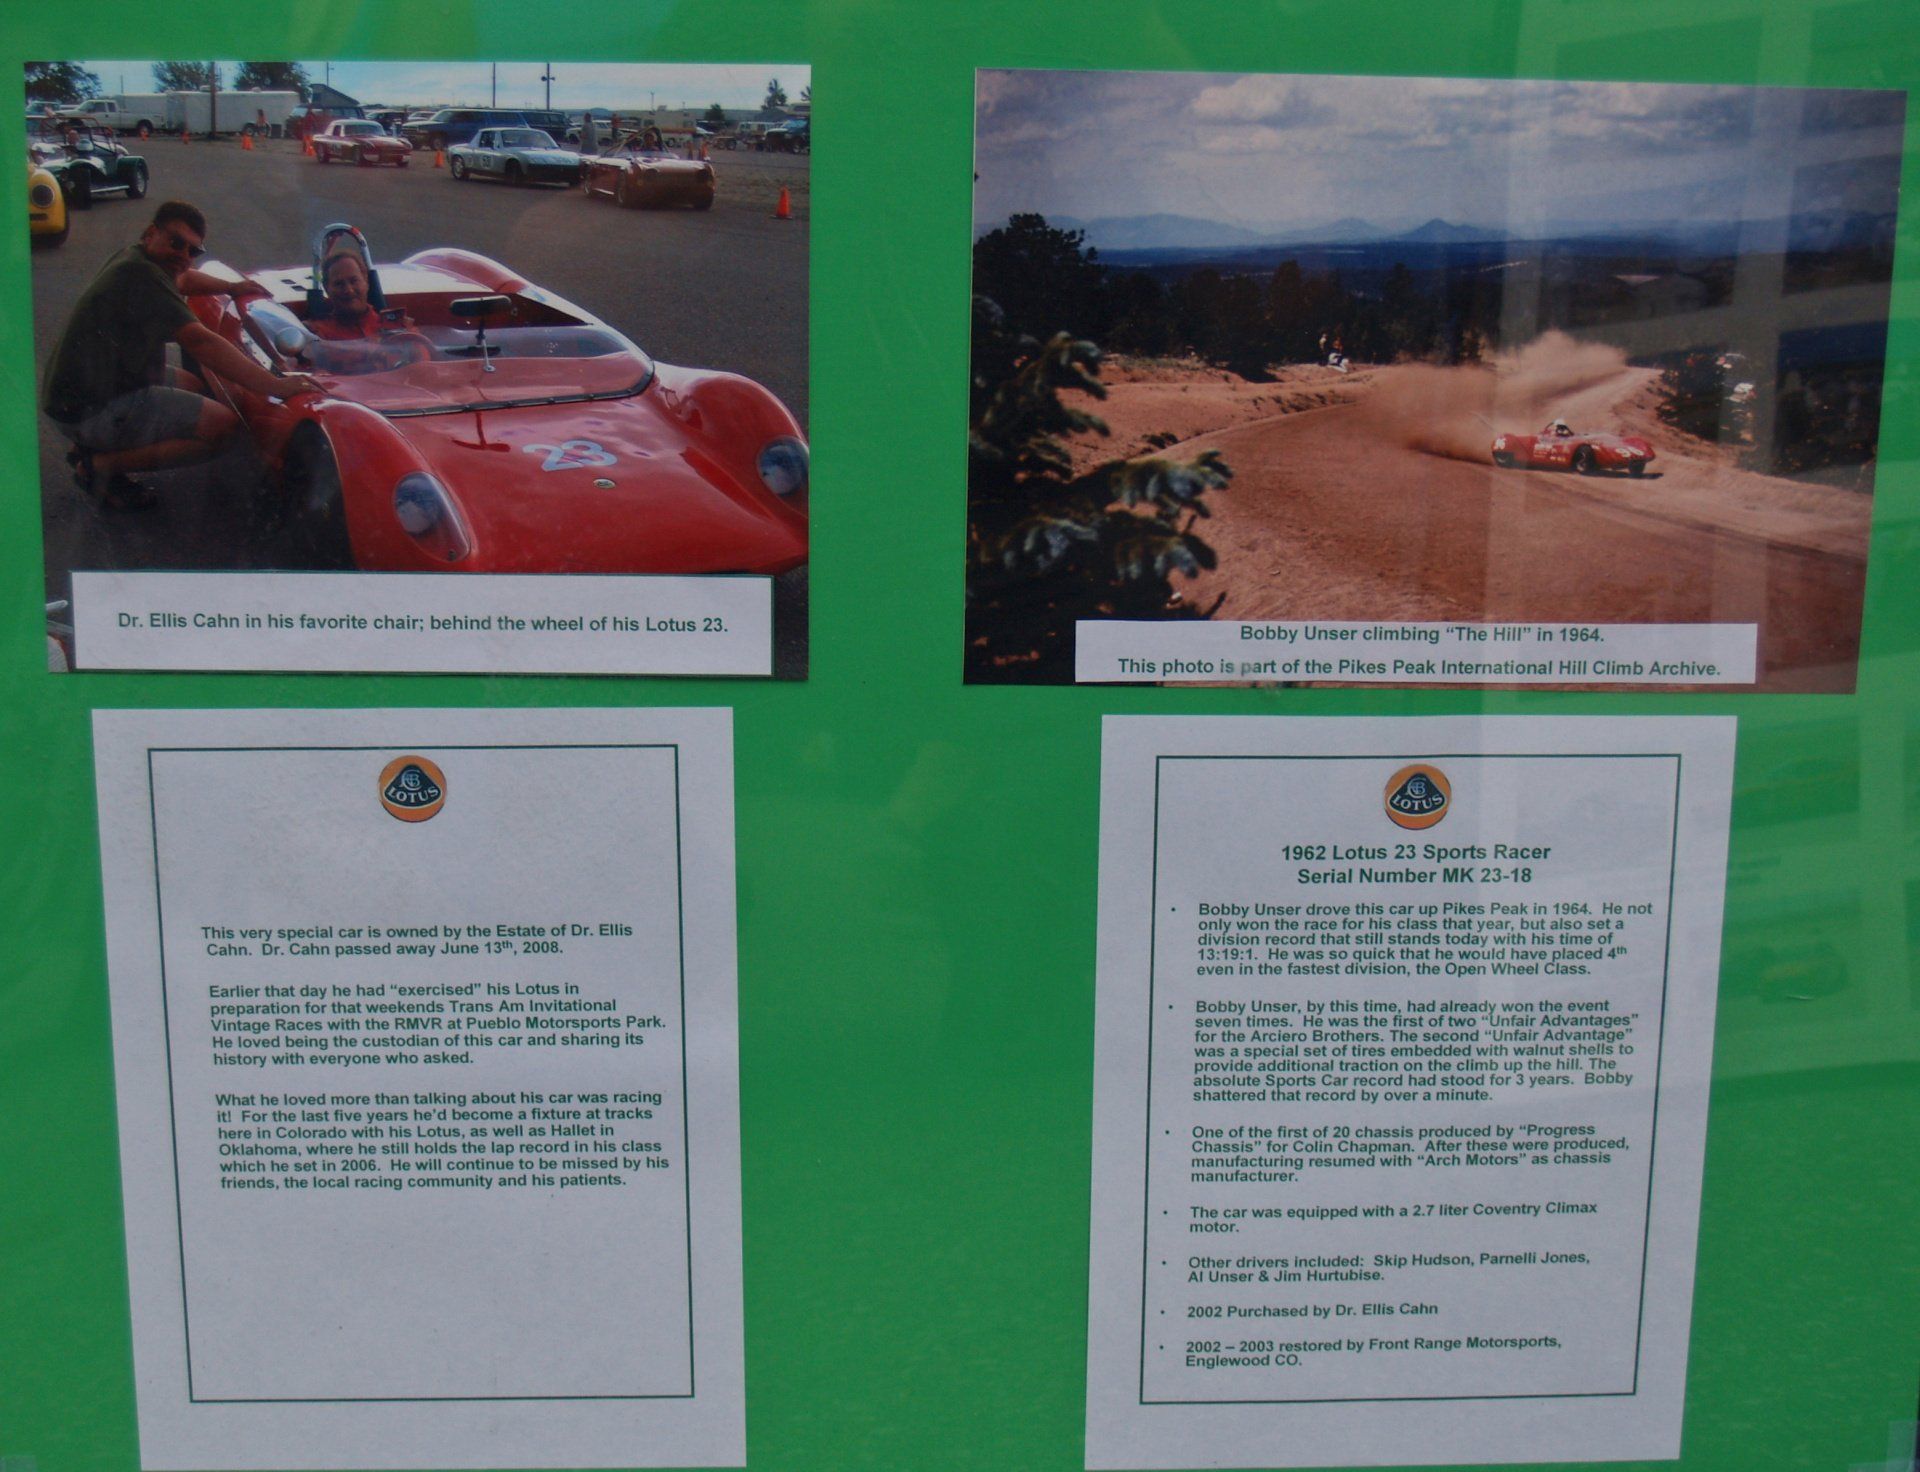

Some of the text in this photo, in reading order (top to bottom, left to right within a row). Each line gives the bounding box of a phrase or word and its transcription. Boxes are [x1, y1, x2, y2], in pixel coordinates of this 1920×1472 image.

[522, 439, 618, 472] 23
[118, 612, 728, 632] Dr. Ellis Cahn in his favorite chair; behind the wheel of his Lotus 23.
[1240, 625, 1604, 645] Bobby Unser climbing “The Hill” in 1964.
[1118, 658, 1720, 677] This photo is part of the Pikes Peak International Hill Climb Archive.
[387, 786, 439, 803] LOTUS
[1392, 794, 1443, 810] LOTUS
[1282, 844, 1552, 864] 1962 Lotus 23 Sports Racer
[1297, 867, 1533, 884] Serial Number MK 23-18
[1199, 902, 1653, 919] Bobby Unser drove this car up Pikes Peak in 1964. He not
[200, 923, 633, 942] This very special car is owned by the Estate of Dr. Ellis
[206, 943, 252, 956] Cahn.
[261, 943, 284, 956] Dr.
[288, 942, 330, 956] Cahn
[335, 942, 391, 959] passed
[396, 944, 436, 958] away
[440, 941, 479, 955] June
[523, 940, 563, 954] 2008.
[210, 998, 617, 1018] preparation for that weekends Trans Am Invitational
[210, 1015, 666, 1035] Vintage Races with the RMVR at Pueblo Motorsports Park.
[213, 1051, 474, 1068] history with everyone who asked.
[218, 1123, 614, 1140] here in Colorado with his Lotus, as well as Hallet in
[1192, 1124, 1596, 1141] One of the first of 20 chassis produced by “Progress
[1191, 1169, 1298, 1183] manufacturer.
[1190, 1201, 1597, 1221] The car was equipped with a 2.7 liter Coventry Climax
[1189, 1221, 1239, 1233] motor.
[1188, 1251, 1590, 1269] Other drivers included: Skip Hudson, Parnelli Jones,
[1188, 1269, 1384, 1283] Al Unser & Jim Hurtubise.
[1187, 1302, 1438, 1319] 2002 Purchased by Dr. Ellis Cahn
